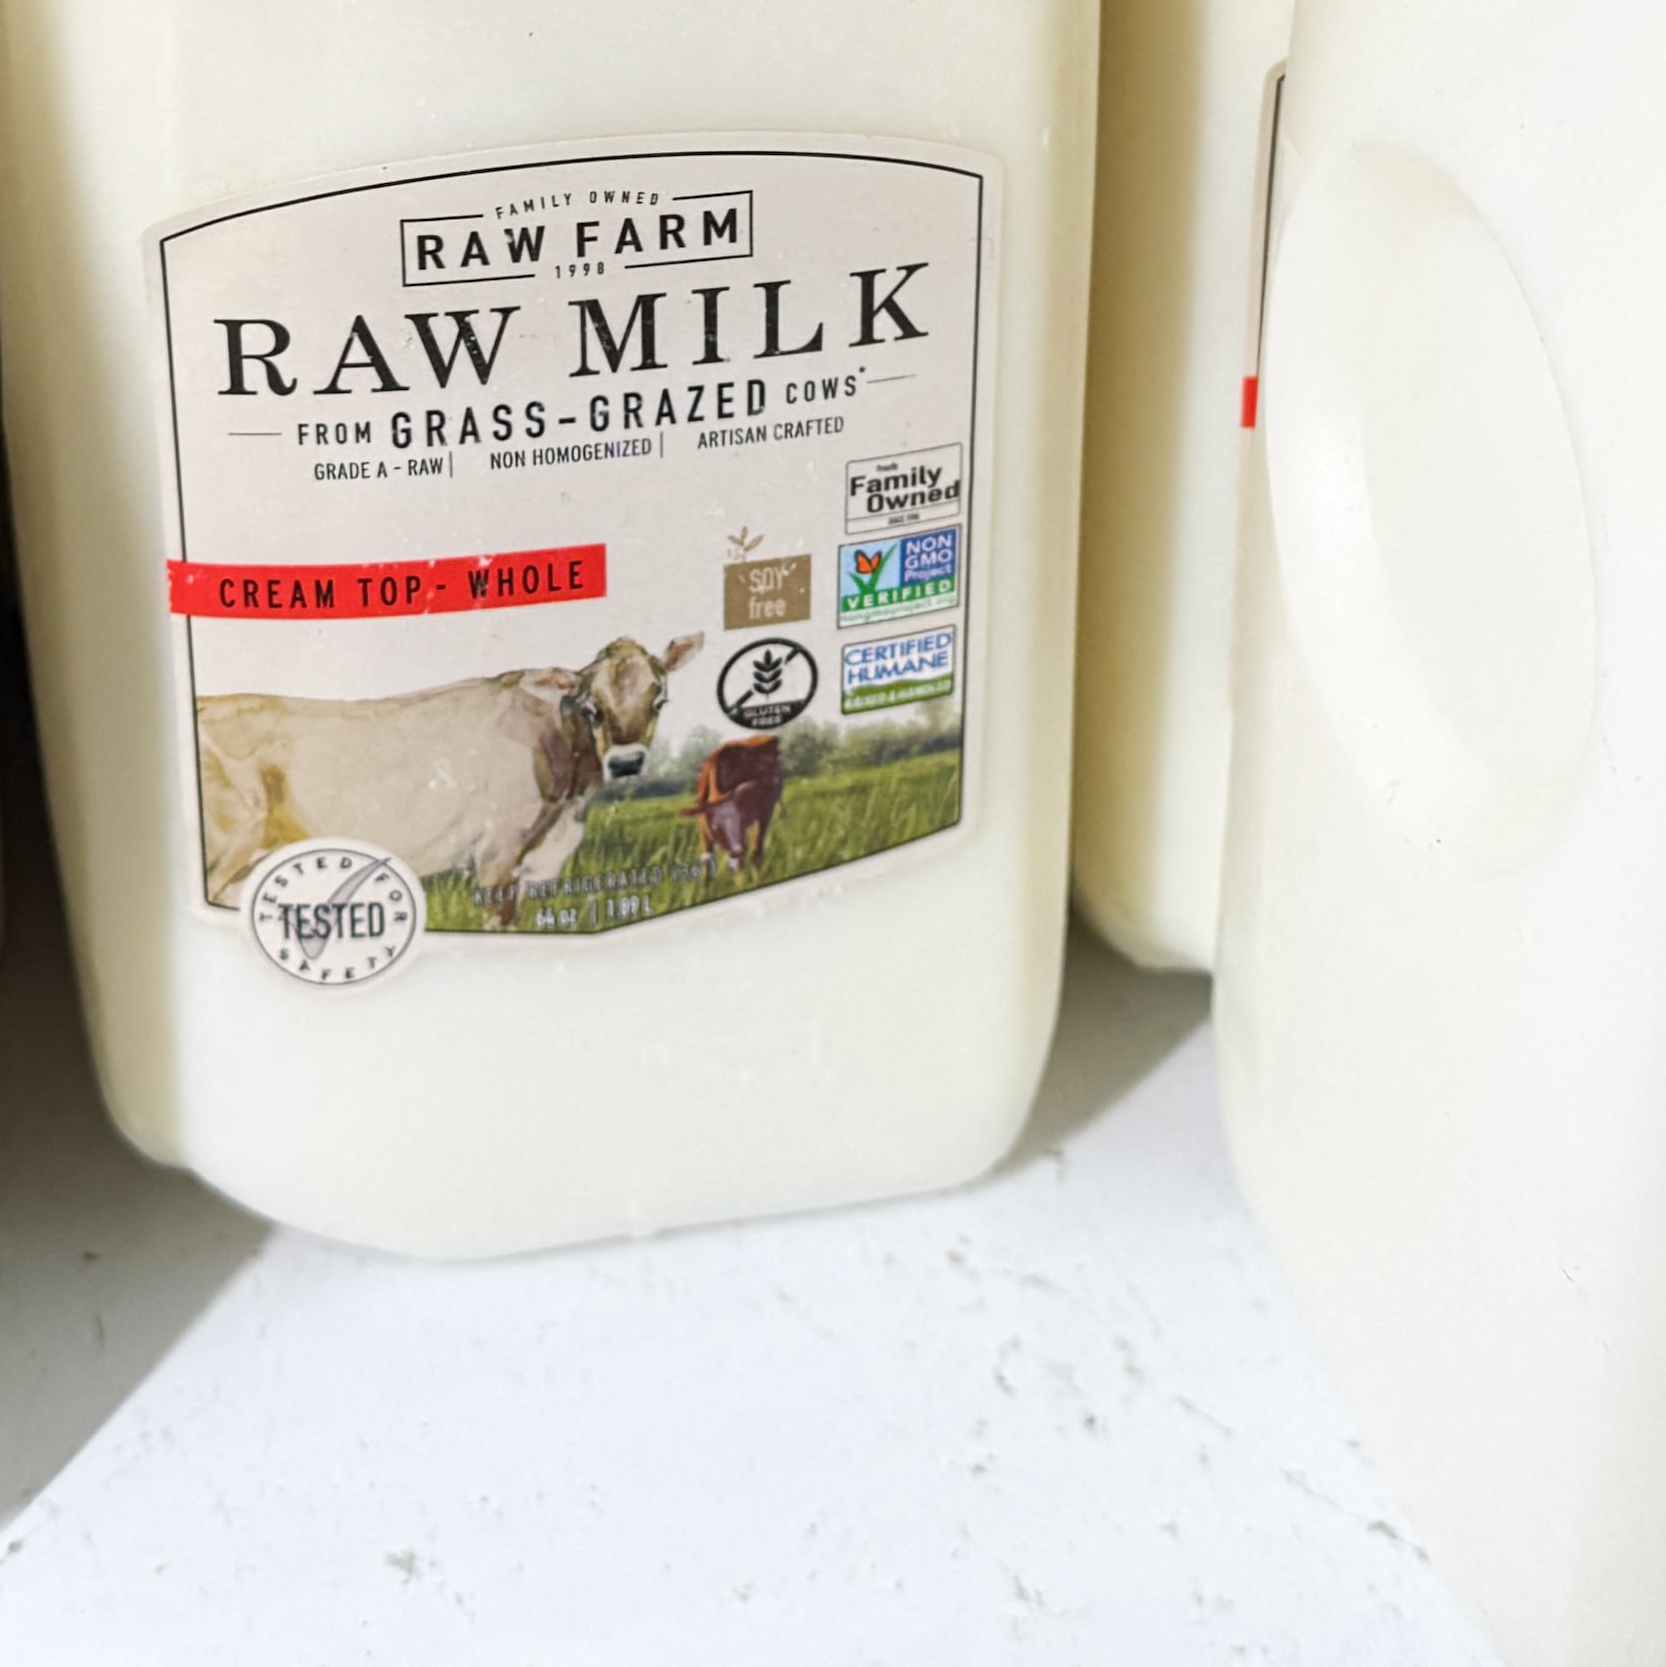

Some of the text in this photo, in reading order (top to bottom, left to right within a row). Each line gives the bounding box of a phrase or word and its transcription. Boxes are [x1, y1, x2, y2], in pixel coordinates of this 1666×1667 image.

[495, 190, 660, 220] FAMILY OWNED
[415, 207, 738, 271] RAW FARM
[554, 261, 606, 280] 1998
[213, 261, 930, 397] RAW MILK
[297, 420, 373, 446] FROM
[390, 379, 767, 450] GRASS-GRAZED
[313, 415, 845, 481] GRADE A RAW NON HOMOGENIZED ARTISAN CRAFTED
[849, 465, 943, 497] Family
[865, 478, 962, 514] Owned
[904, 550, 953, 571] GMO
[905, 535, 953, 556] NON
[219, 560, 584, 610] CREAM TOP WHOLE
[748, 566, 786, 594] SOY
[846, 581, 952, 610] VERIFIED
[748, 596, 787, 620] free
[844, 632, 953, 666] CERTIFIED
[846, 650, 949, 685] HUMANE
[258, 855, 353, 922] TESTED
[278, 901, 387, 942] TESTED
[278, 944, 398, 983] SAFETY
